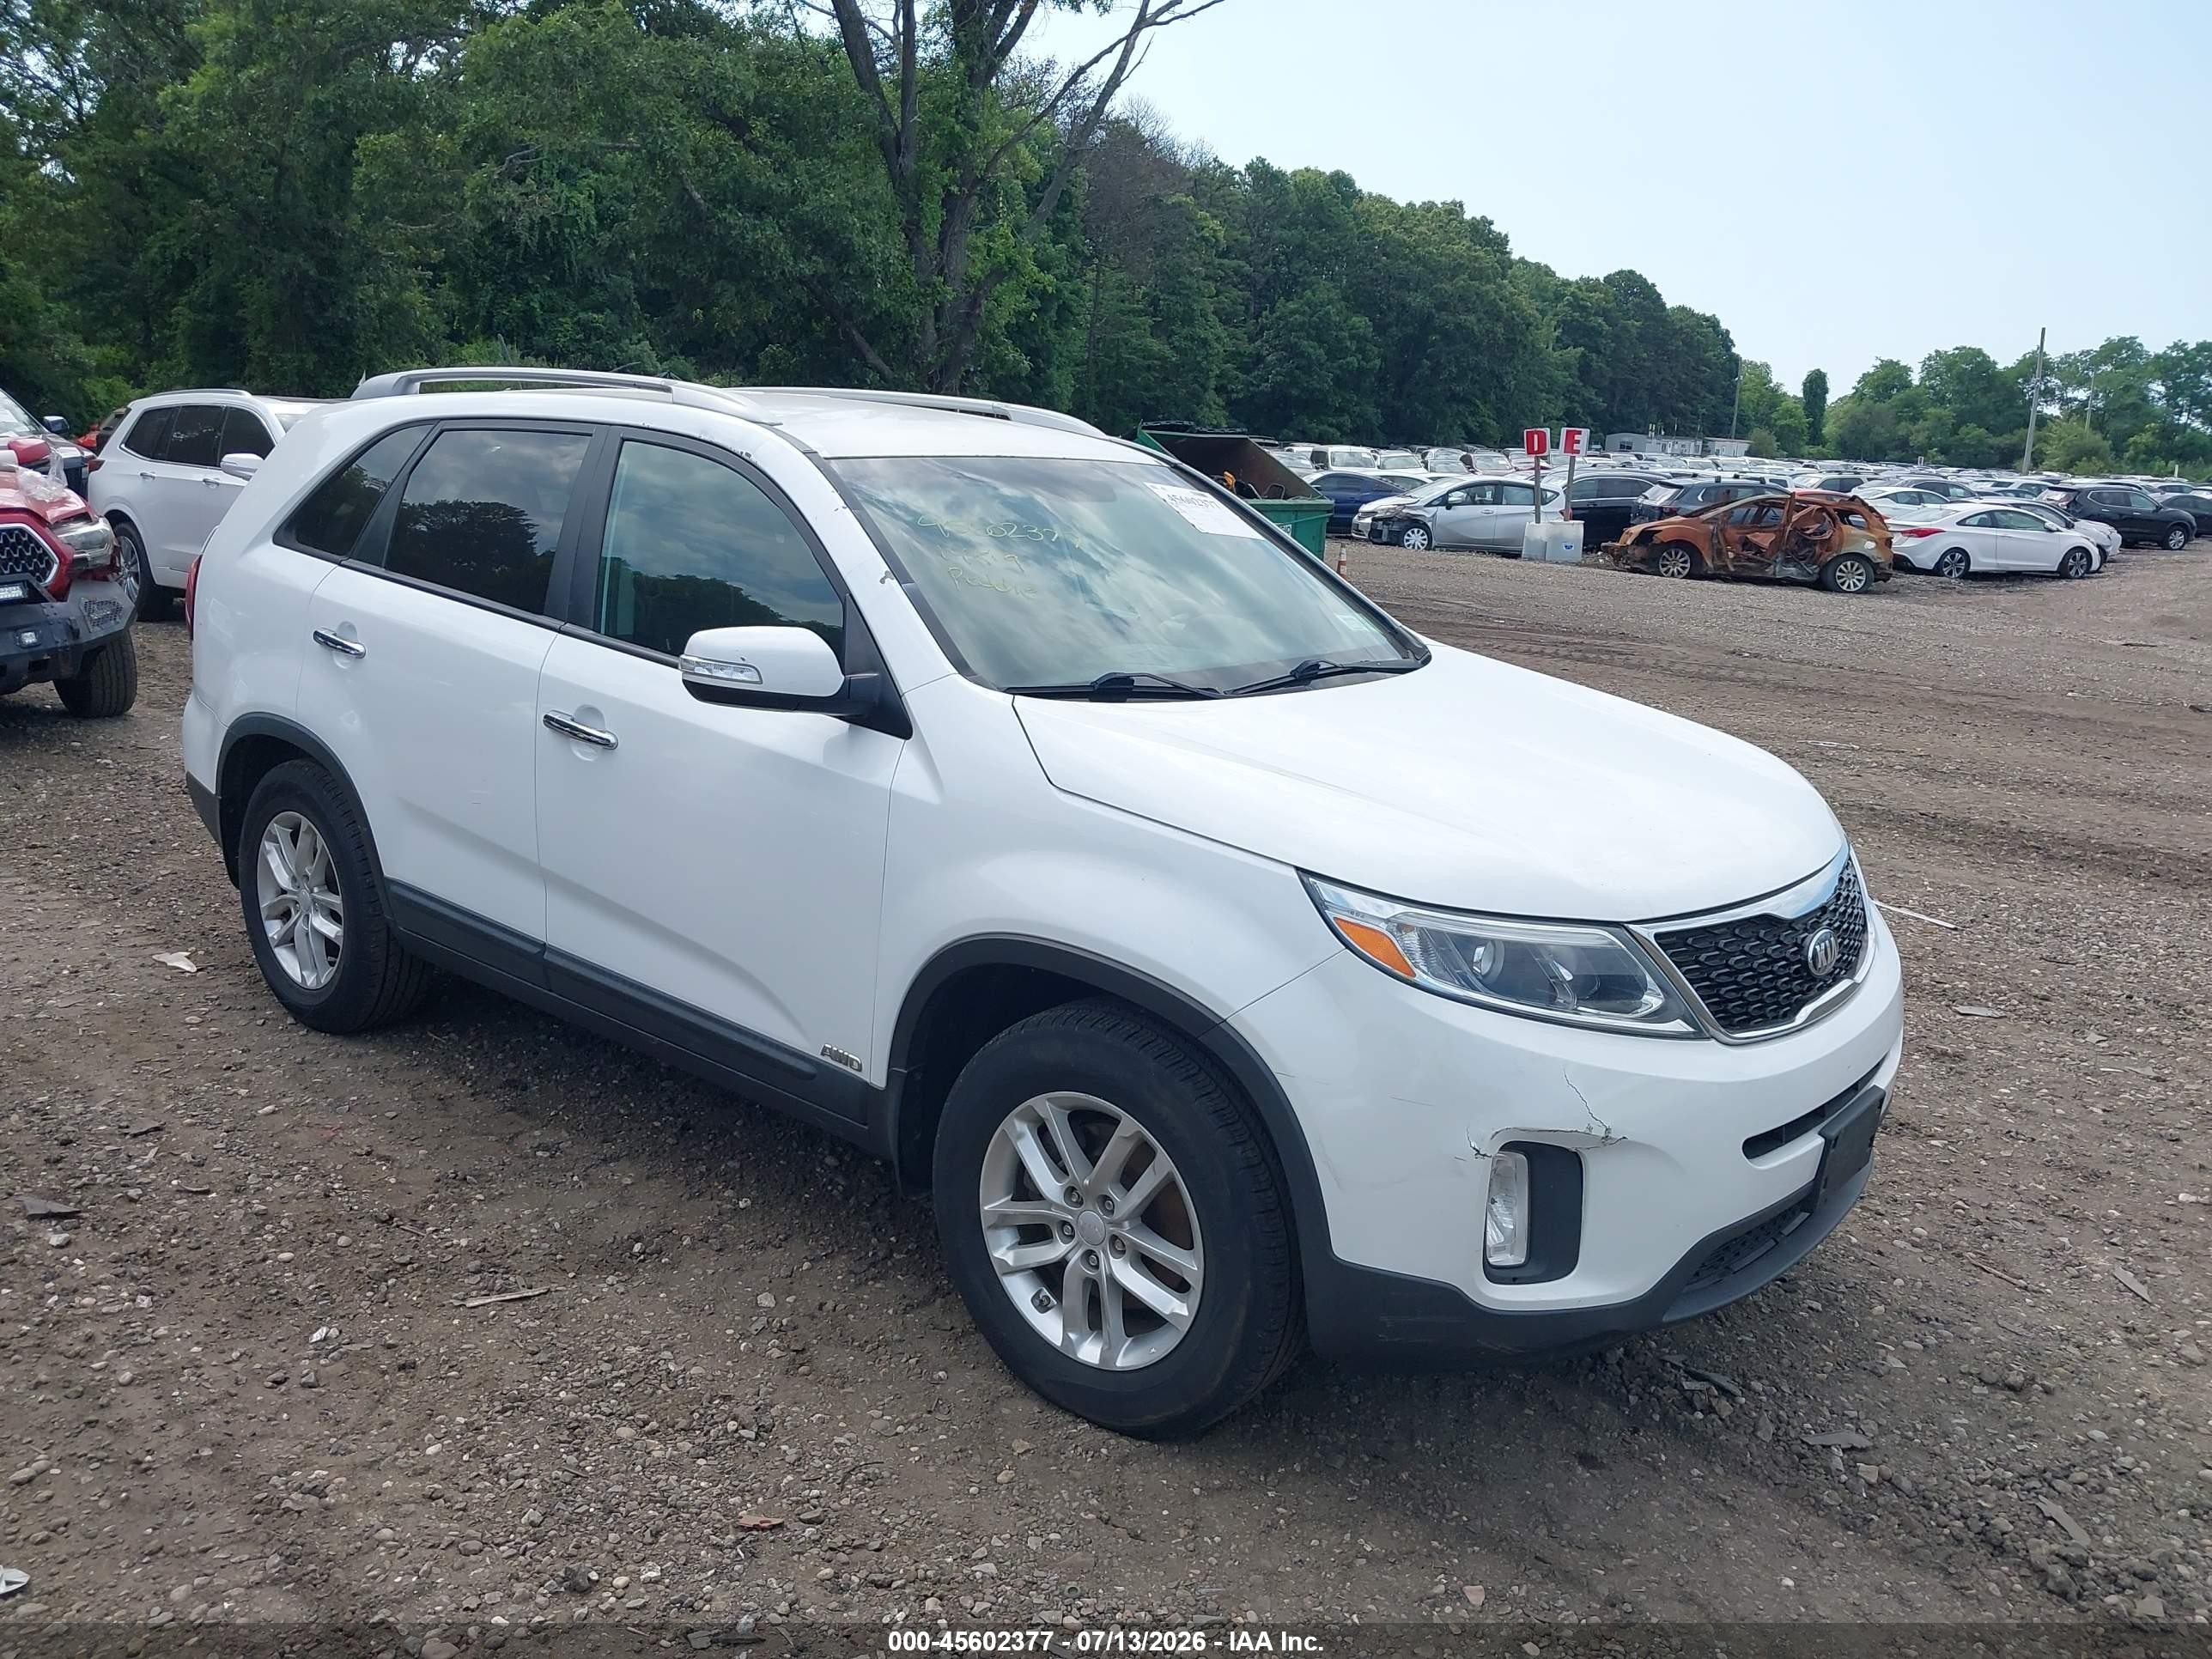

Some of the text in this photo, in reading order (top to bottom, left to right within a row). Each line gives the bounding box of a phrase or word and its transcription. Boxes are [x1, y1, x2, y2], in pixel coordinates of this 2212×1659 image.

[1526, 429, 1547, 455] D
[1564, 429, 1583, 454] E
[821, 1042, 863, 1073] AWD
